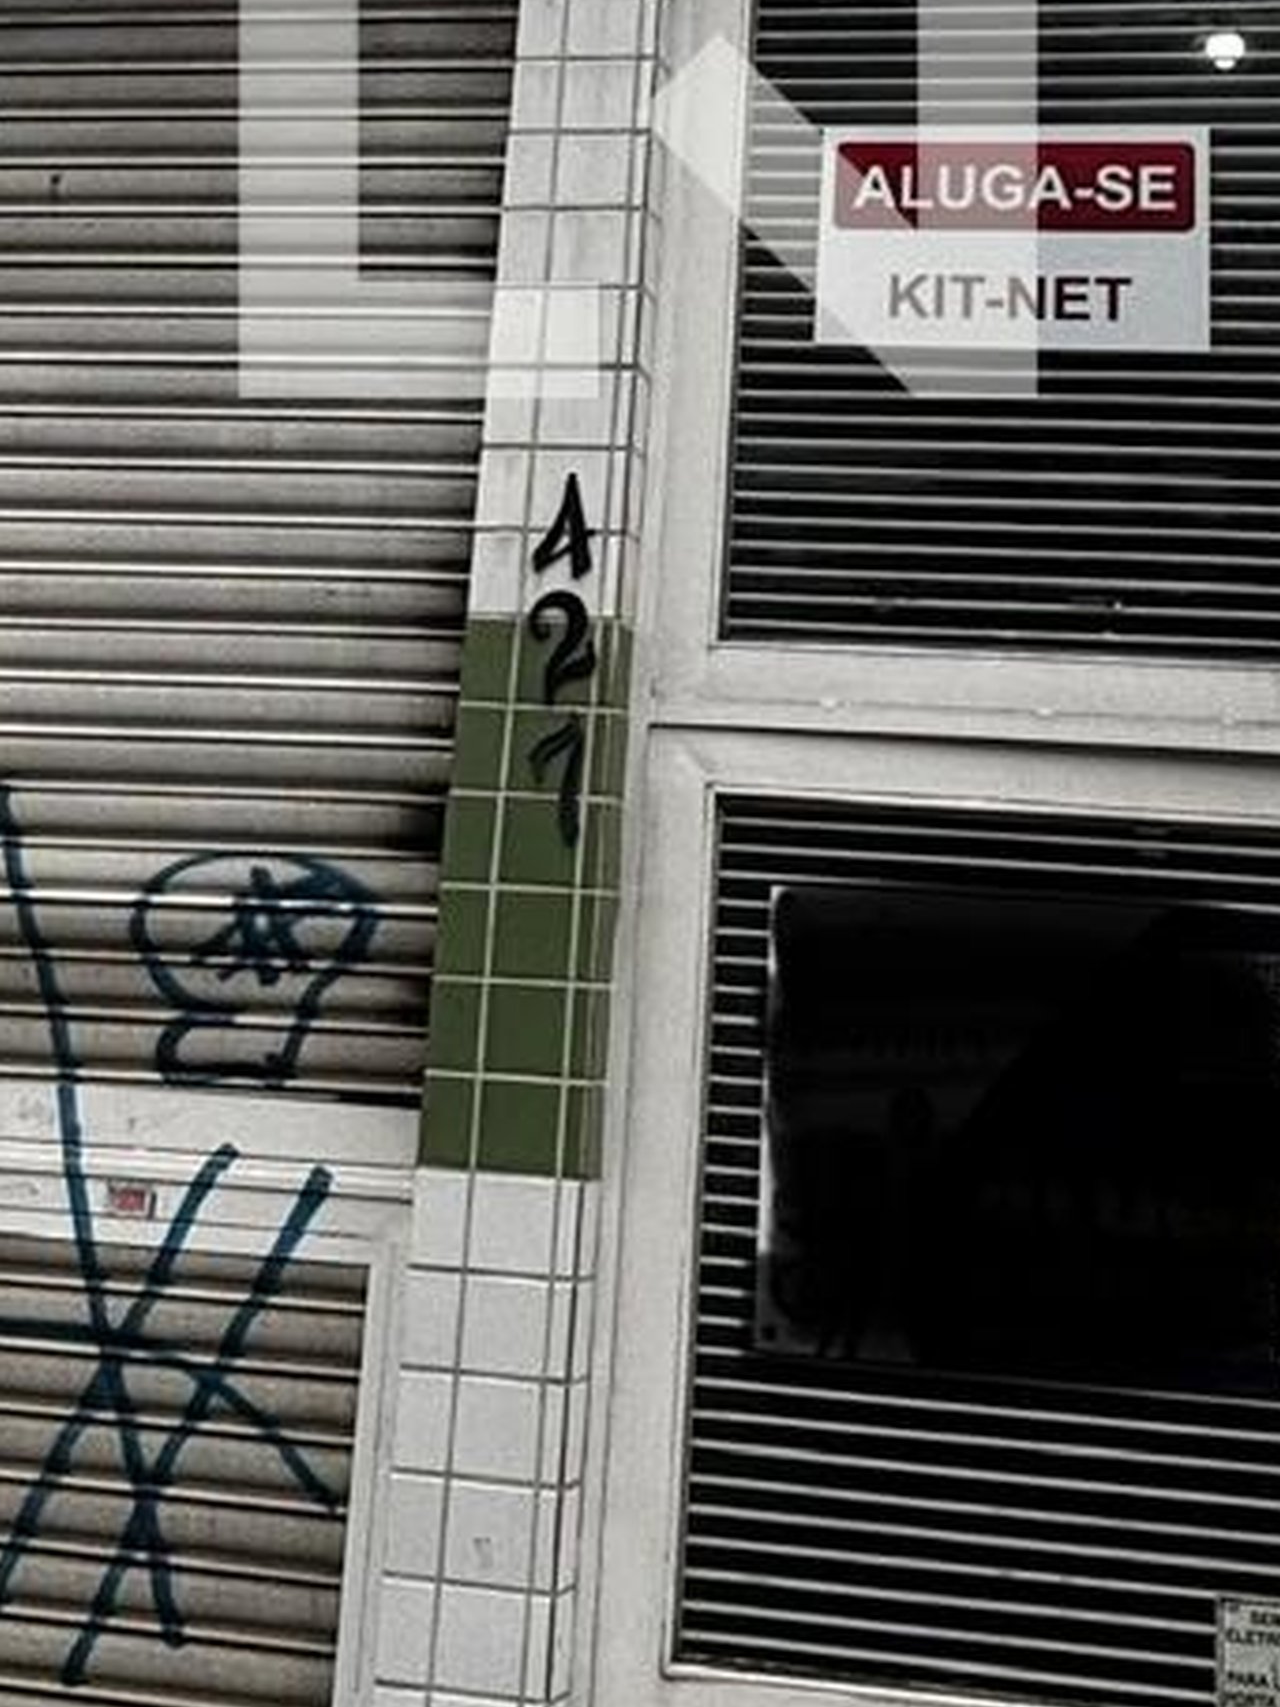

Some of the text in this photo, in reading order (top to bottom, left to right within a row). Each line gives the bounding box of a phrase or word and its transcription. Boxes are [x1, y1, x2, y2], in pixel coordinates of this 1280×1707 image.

[852, 164, 1178, 212] ALUGA-SE
[888, 274, 1133, 322] KIT-NET
[528, 472, 597, 849] 421
[1226, 1670, 1270, 1689] PARA
